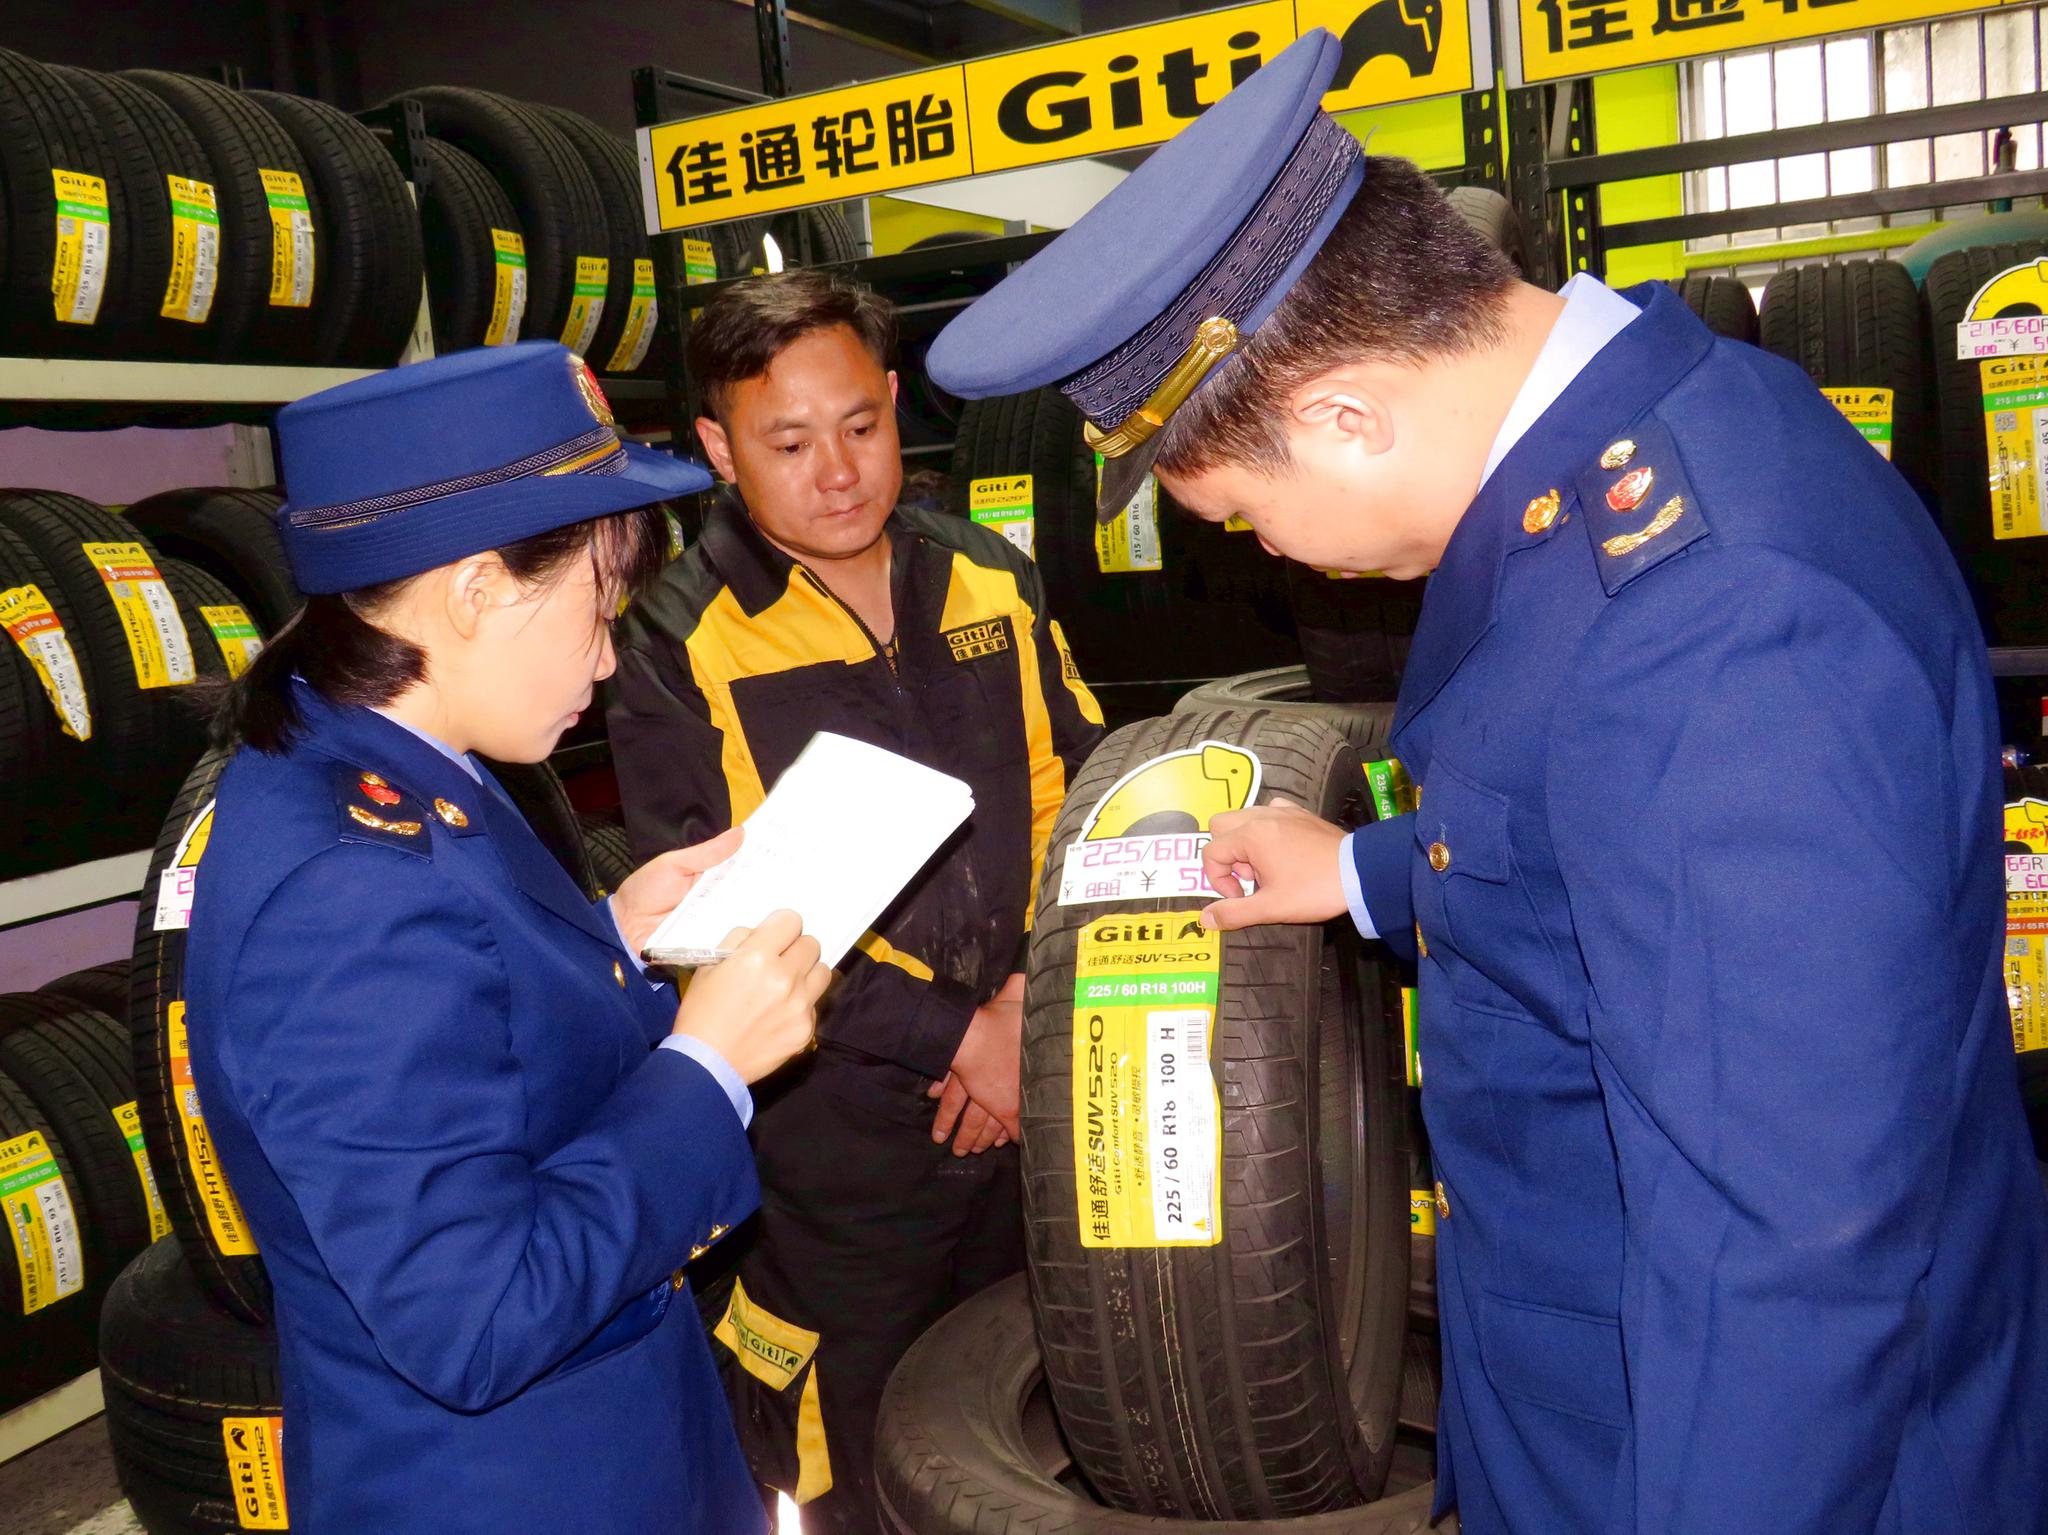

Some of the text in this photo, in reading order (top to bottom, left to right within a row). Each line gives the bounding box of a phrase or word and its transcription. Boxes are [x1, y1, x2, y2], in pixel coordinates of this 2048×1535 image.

[997, 31, 1261, 144] Giti
[666, 94, 955, 207] 佳通轮胎
[60, 176, 86, 187] Giti
[1990, 361, 2035, 375] Giti
[977, 482, 1007, 493] Giti
[1132, 503, 1140, 520] R16
[1133, 524, 1140, 536] 60
[92, 547, 123, 555] Giti
[1134, 543, 1142, 559] 215
[949, 627, 986, 646] Giti
[1376, 774, 1388, 792] 235
[1381, 799, 1391, 811] 45
[1141, 870, 1157, 892] ¥
[1094, 924, 1163, 942] Giti
[1088, 985, 1112, 998] 225
[1121, 983, 1138, 996] 60
[1140, 982, 1167, 995] R18
[1170, 980, 1206, 994] 100H
[1160, 1027, 1175, 1040] H
[1161, 1053, 1175, 1086] 100
[1162, 1100, 1177, 1135] R18
[1113, 1119, 1121, 1165] Comfort
[0, 1144, 22, 1159] iti
[1163, 1147, 1178, 1170] 60
[1114, 1171, 1122, 1196] Giti
[48, 1207, 57, 1220] 93
[1166, 1189, 1182, 1223] 225
[53, 1224, 63, 1243] R16
[751, 1339, 779, 1361] Giti
[254, 1426, 271, 1480] HT152
[238, 1462, 260, 1518] Giti
